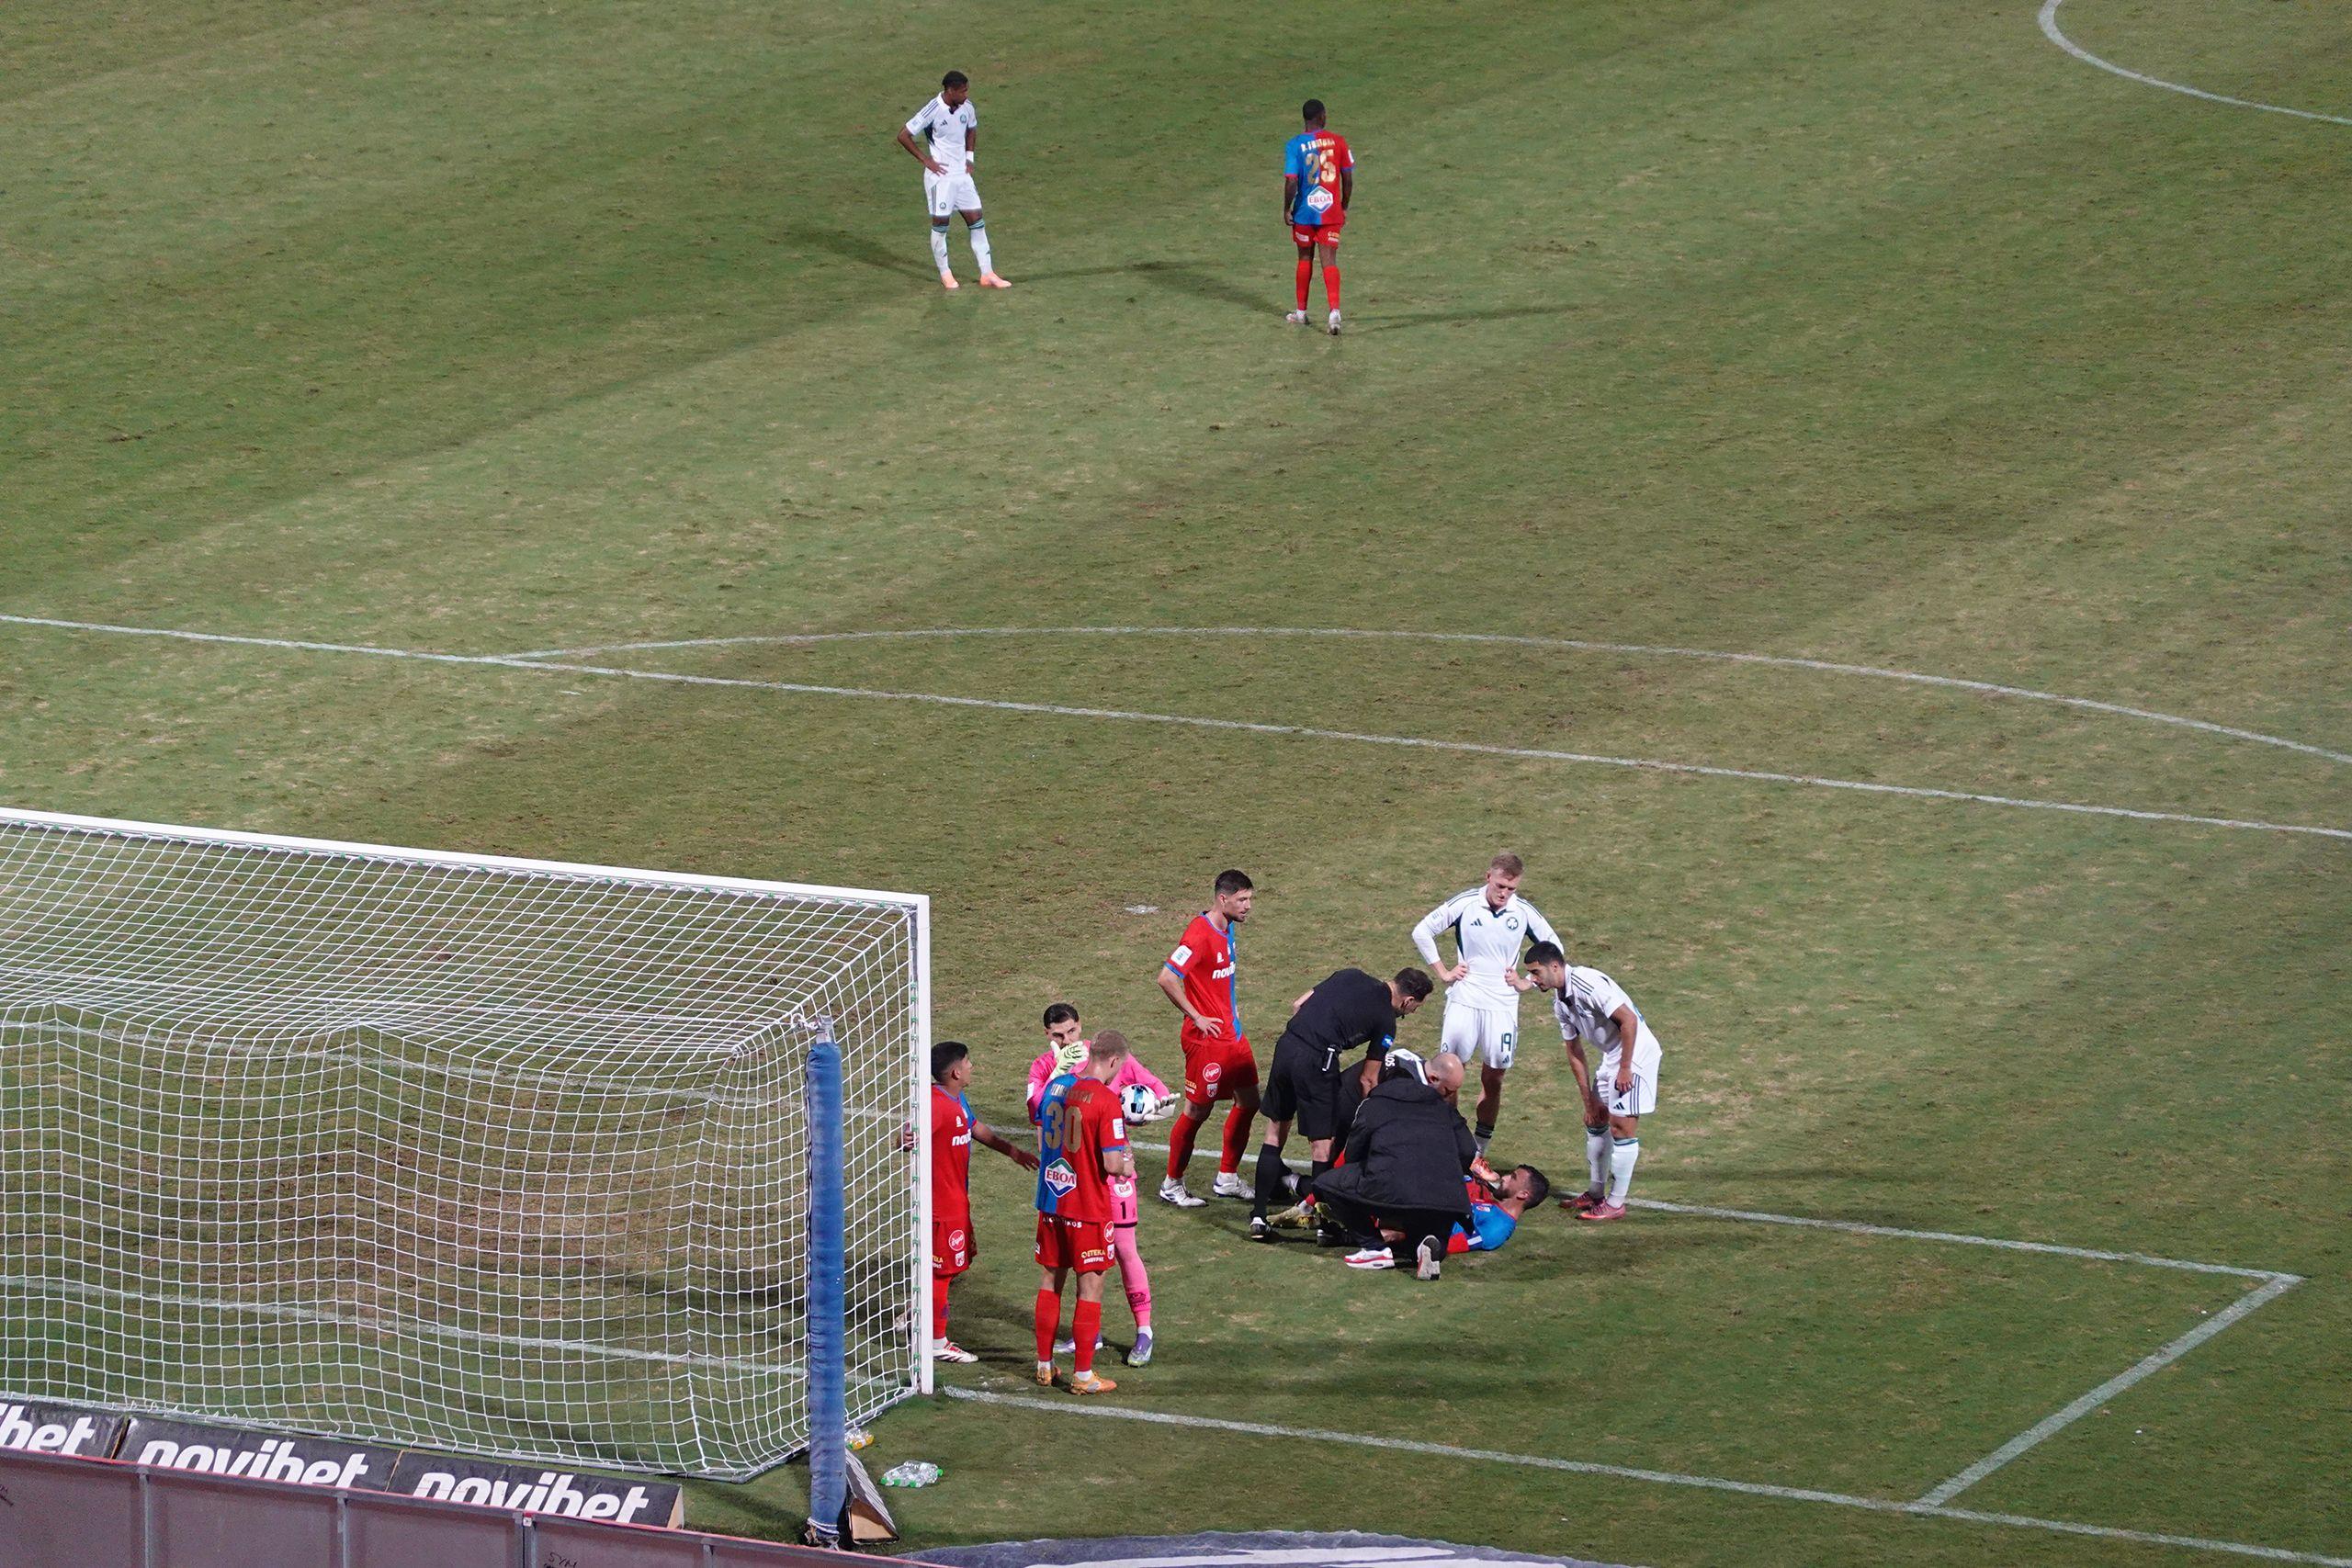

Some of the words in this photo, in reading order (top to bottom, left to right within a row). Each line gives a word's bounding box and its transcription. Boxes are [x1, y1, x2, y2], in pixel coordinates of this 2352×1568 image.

[1306, 149, 1336, 184] 25
[1500, 1032, 1512, 1053] 19
[1045, 1101, 1082, 1154] 30
[1120, 1201, 1127, 1220] 1
[137, 1438, 369, 1489] novibet
[413, 1472, 649, 1523] novibet
